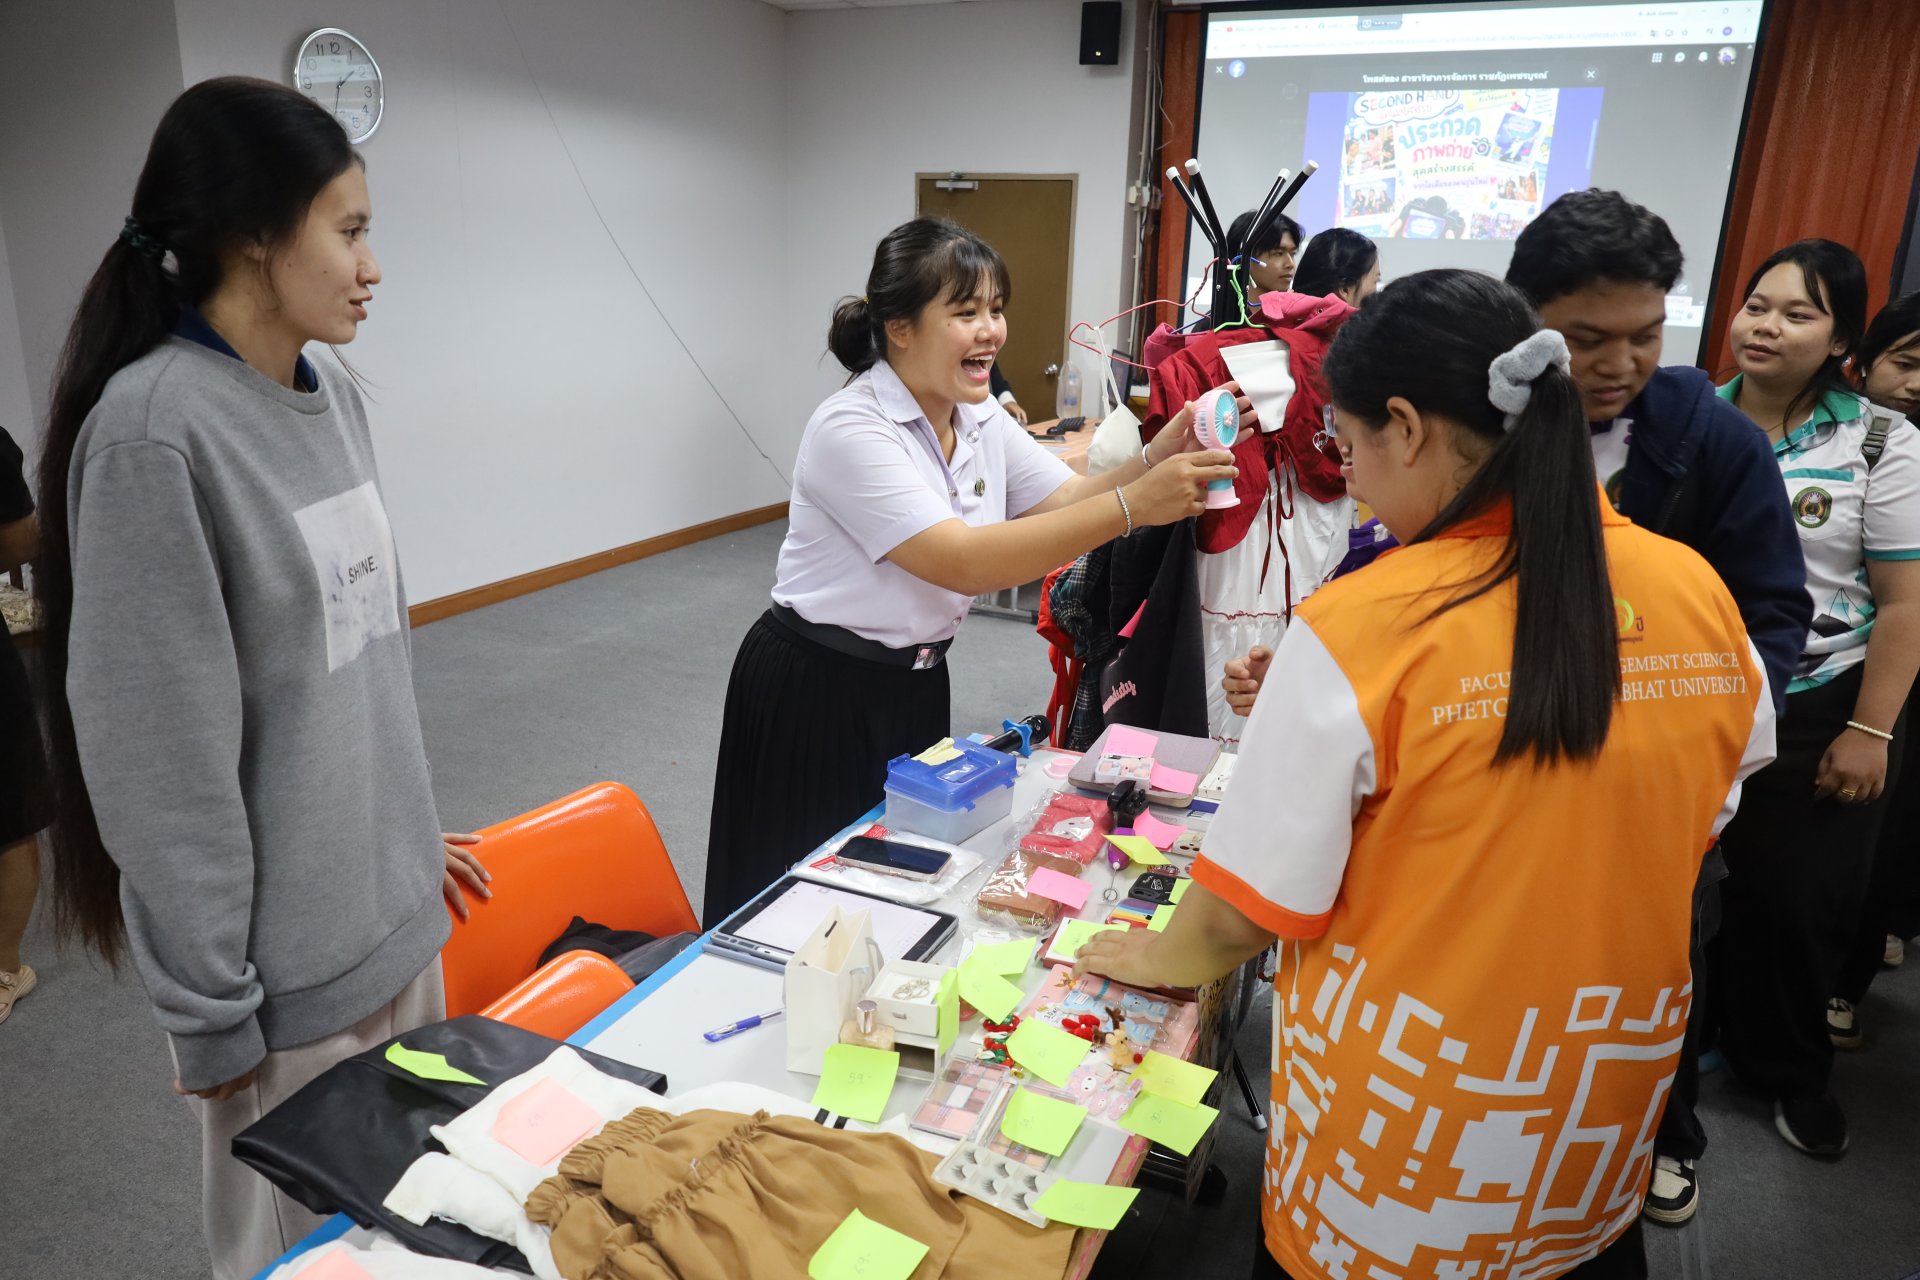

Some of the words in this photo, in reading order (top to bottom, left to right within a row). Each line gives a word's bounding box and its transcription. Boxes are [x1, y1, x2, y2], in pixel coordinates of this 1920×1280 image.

[316, 44, 324, 56] 11
[330, 42, 340, 55] 12
[304, 77, 312, 89] 9
[359, 66, 366, 78] 2
[364, 86, 372, 98] 3
[1360, 93, 1413, 113] SECOND
[1416, 90, 1454, 103] HAND
[1399, 117, 1481, 149] ประกวด
[1413, 138, 1473, 163] ภาพถ่าย
[348, 555, 378, 584] SHINE.
[1460, 671, 1511, 694] FACU
[1620, 654, 1679, 674] GEMENT
[1431, 697, 1508, 725] PHETC
[1622, 679, 1665, 701] BHAT
[1670, 675, 1746, 697] UNIVERSIT
